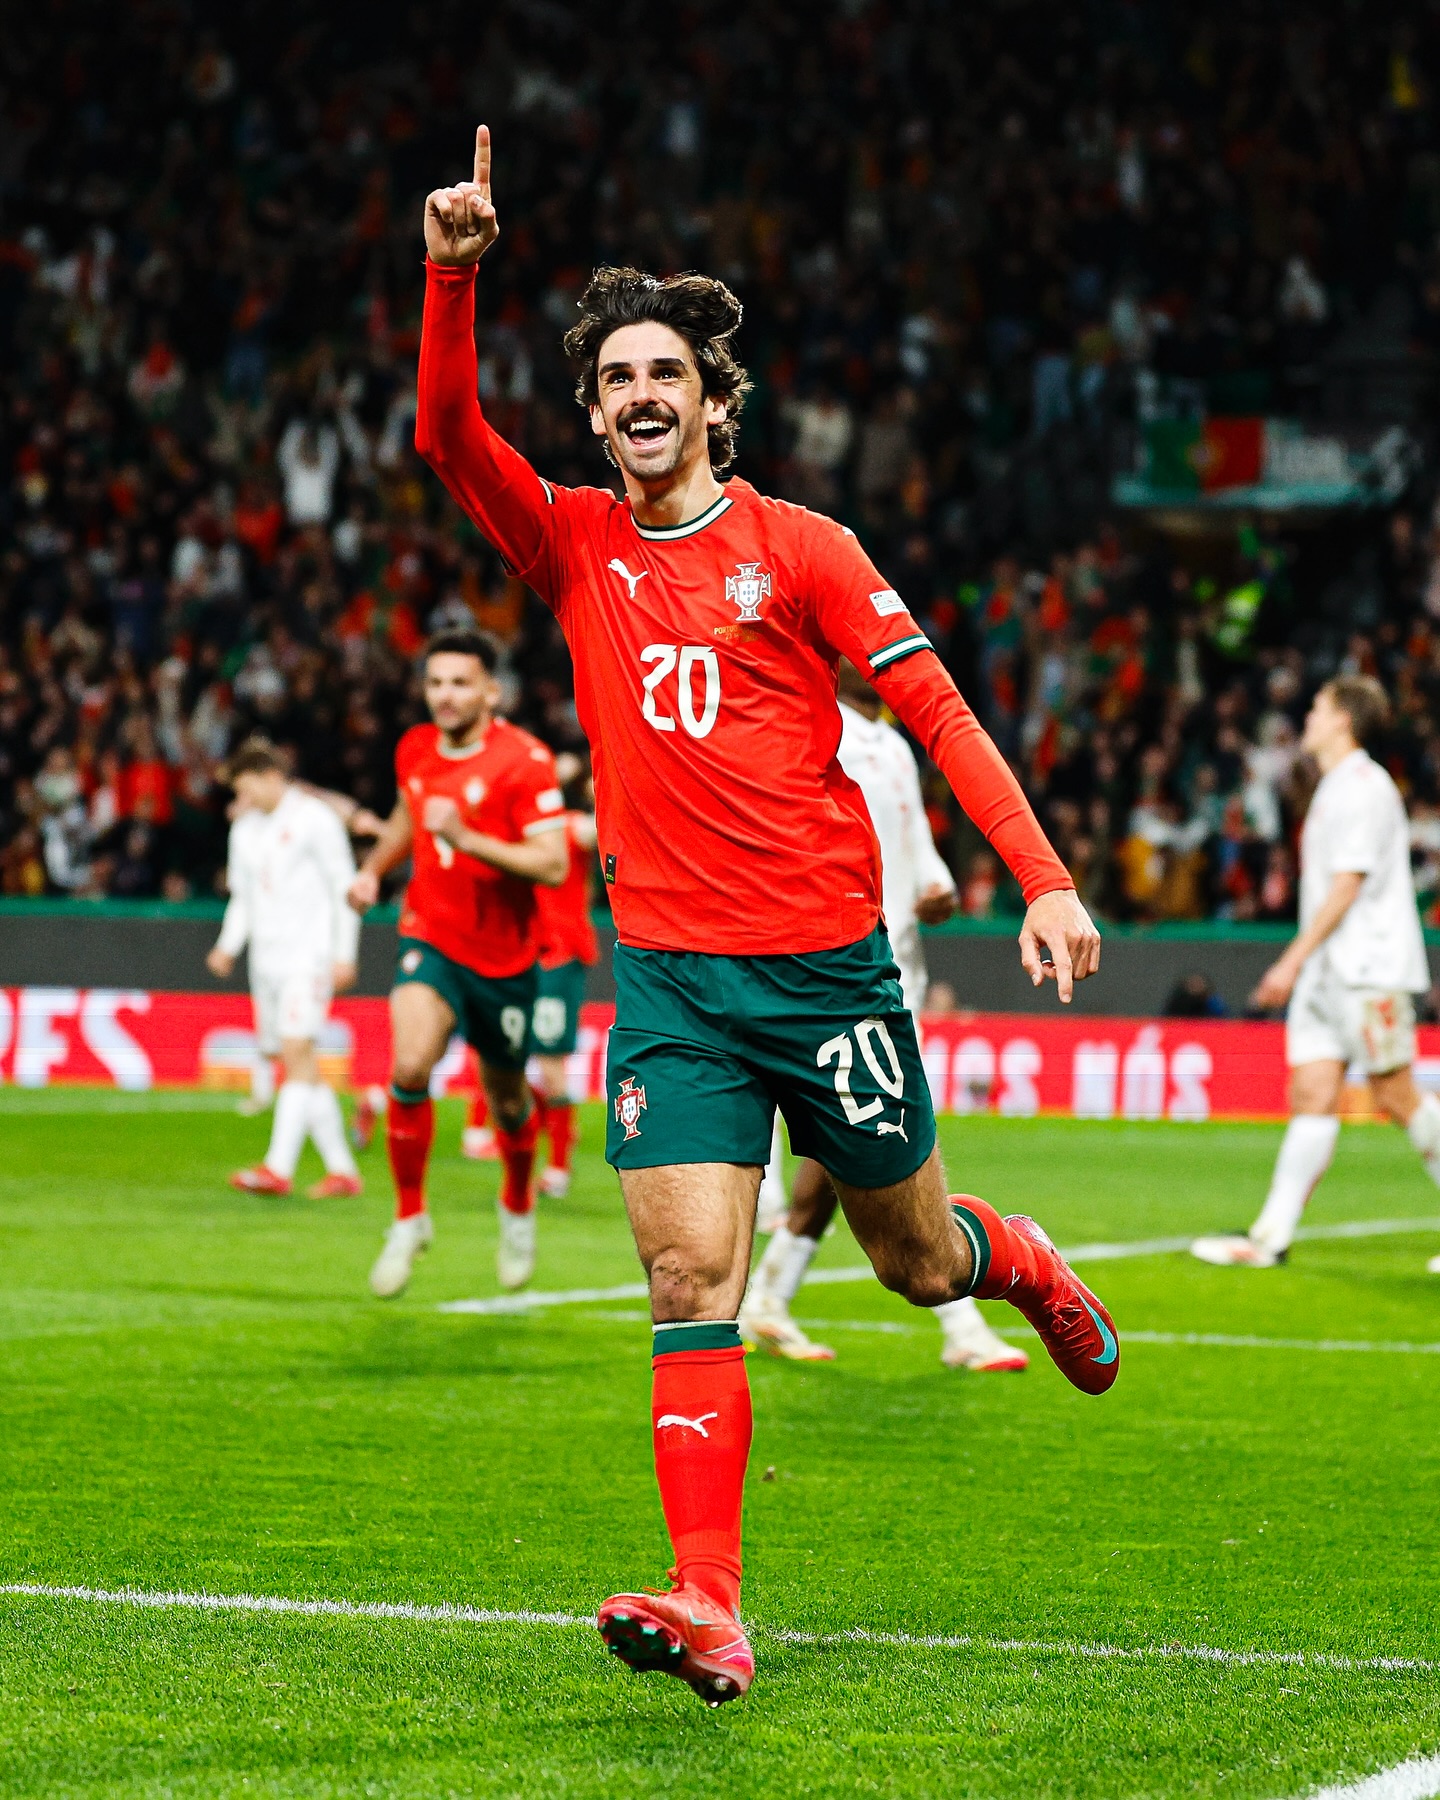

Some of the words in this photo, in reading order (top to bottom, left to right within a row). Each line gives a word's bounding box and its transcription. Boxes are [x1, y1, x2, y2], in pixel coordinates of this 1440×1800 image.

[640, 644, 720, 738] 20
[501, 1005, 526, 1053] 9
[816, 1015, 904, 1125] 20
